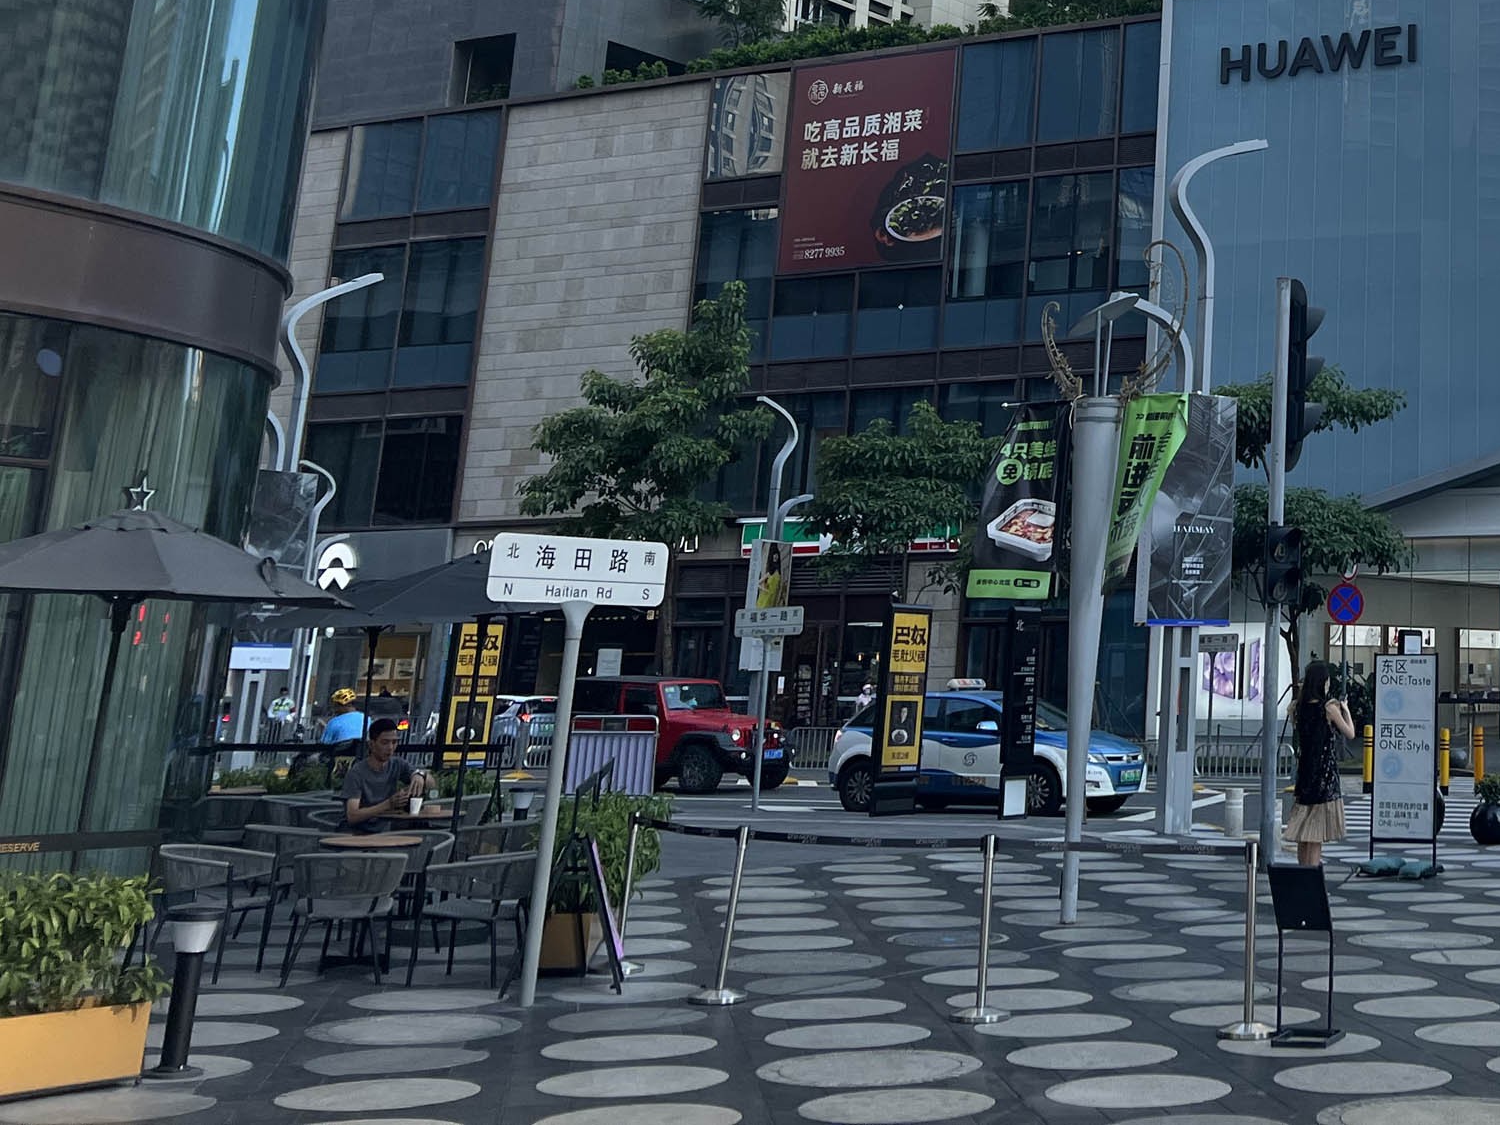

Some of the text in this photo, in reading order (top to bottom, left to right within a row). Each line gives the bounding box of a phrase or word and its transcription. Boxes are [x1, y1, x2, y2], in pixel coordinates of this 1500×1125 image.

[1220, 24, 1418, 85] HUAWEI
[804, 109, 924, 143] 吃高品质湘菜
[801, 139, 900, 170] 就去新长福
[804, 248, 825, 259] 8277
[507, 542, 657, 573] 北 海田路 南
[503, 583, 650, 600] N Haitian Rd S
[894, 625, 927, 645] 巴奴
[1381, 659, 1408, 674] 东区
[1380, 724, 1407, 739] 西区
